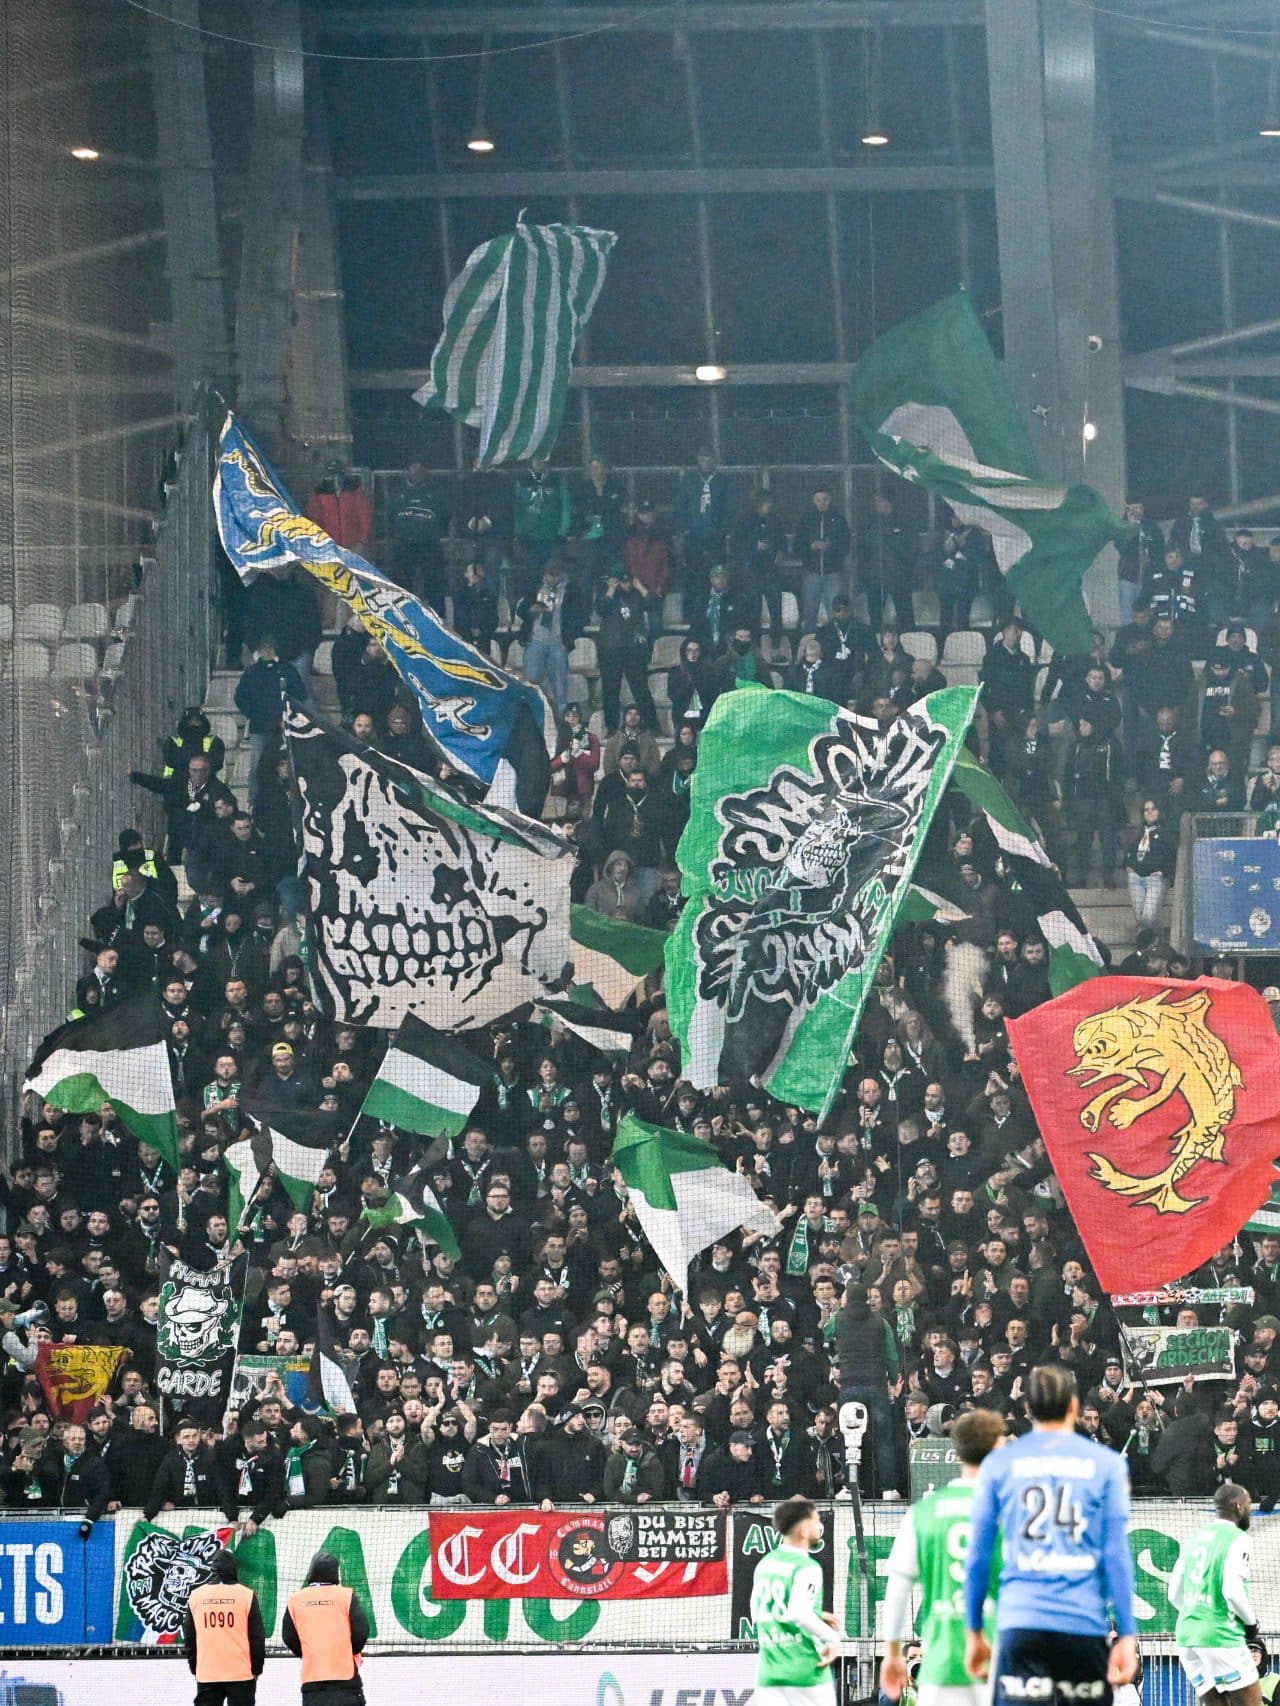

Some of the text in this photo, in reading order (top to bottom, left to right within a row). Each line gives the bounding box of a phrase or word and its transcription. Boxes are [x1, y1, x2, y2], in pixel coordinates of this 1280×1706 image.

[1167, 1330, 1230, 1350] SECTION
[1158, 1348, 1231, 1367] ARDECHE
[157, 1366, 222, 1397] GARDE
[638, 1515, 718, 1529] DU BIST
[1022, 1483, 1088, 1543] 24
[638, 1530, 718, 1545] IMMER
[742, 1524, 825, 1555] AVC
[638, 1546, 718, 1558] BEI UNS!
[0, 1542, 64, 1625] TS
[204, 1611, 235, 1628] 1090
